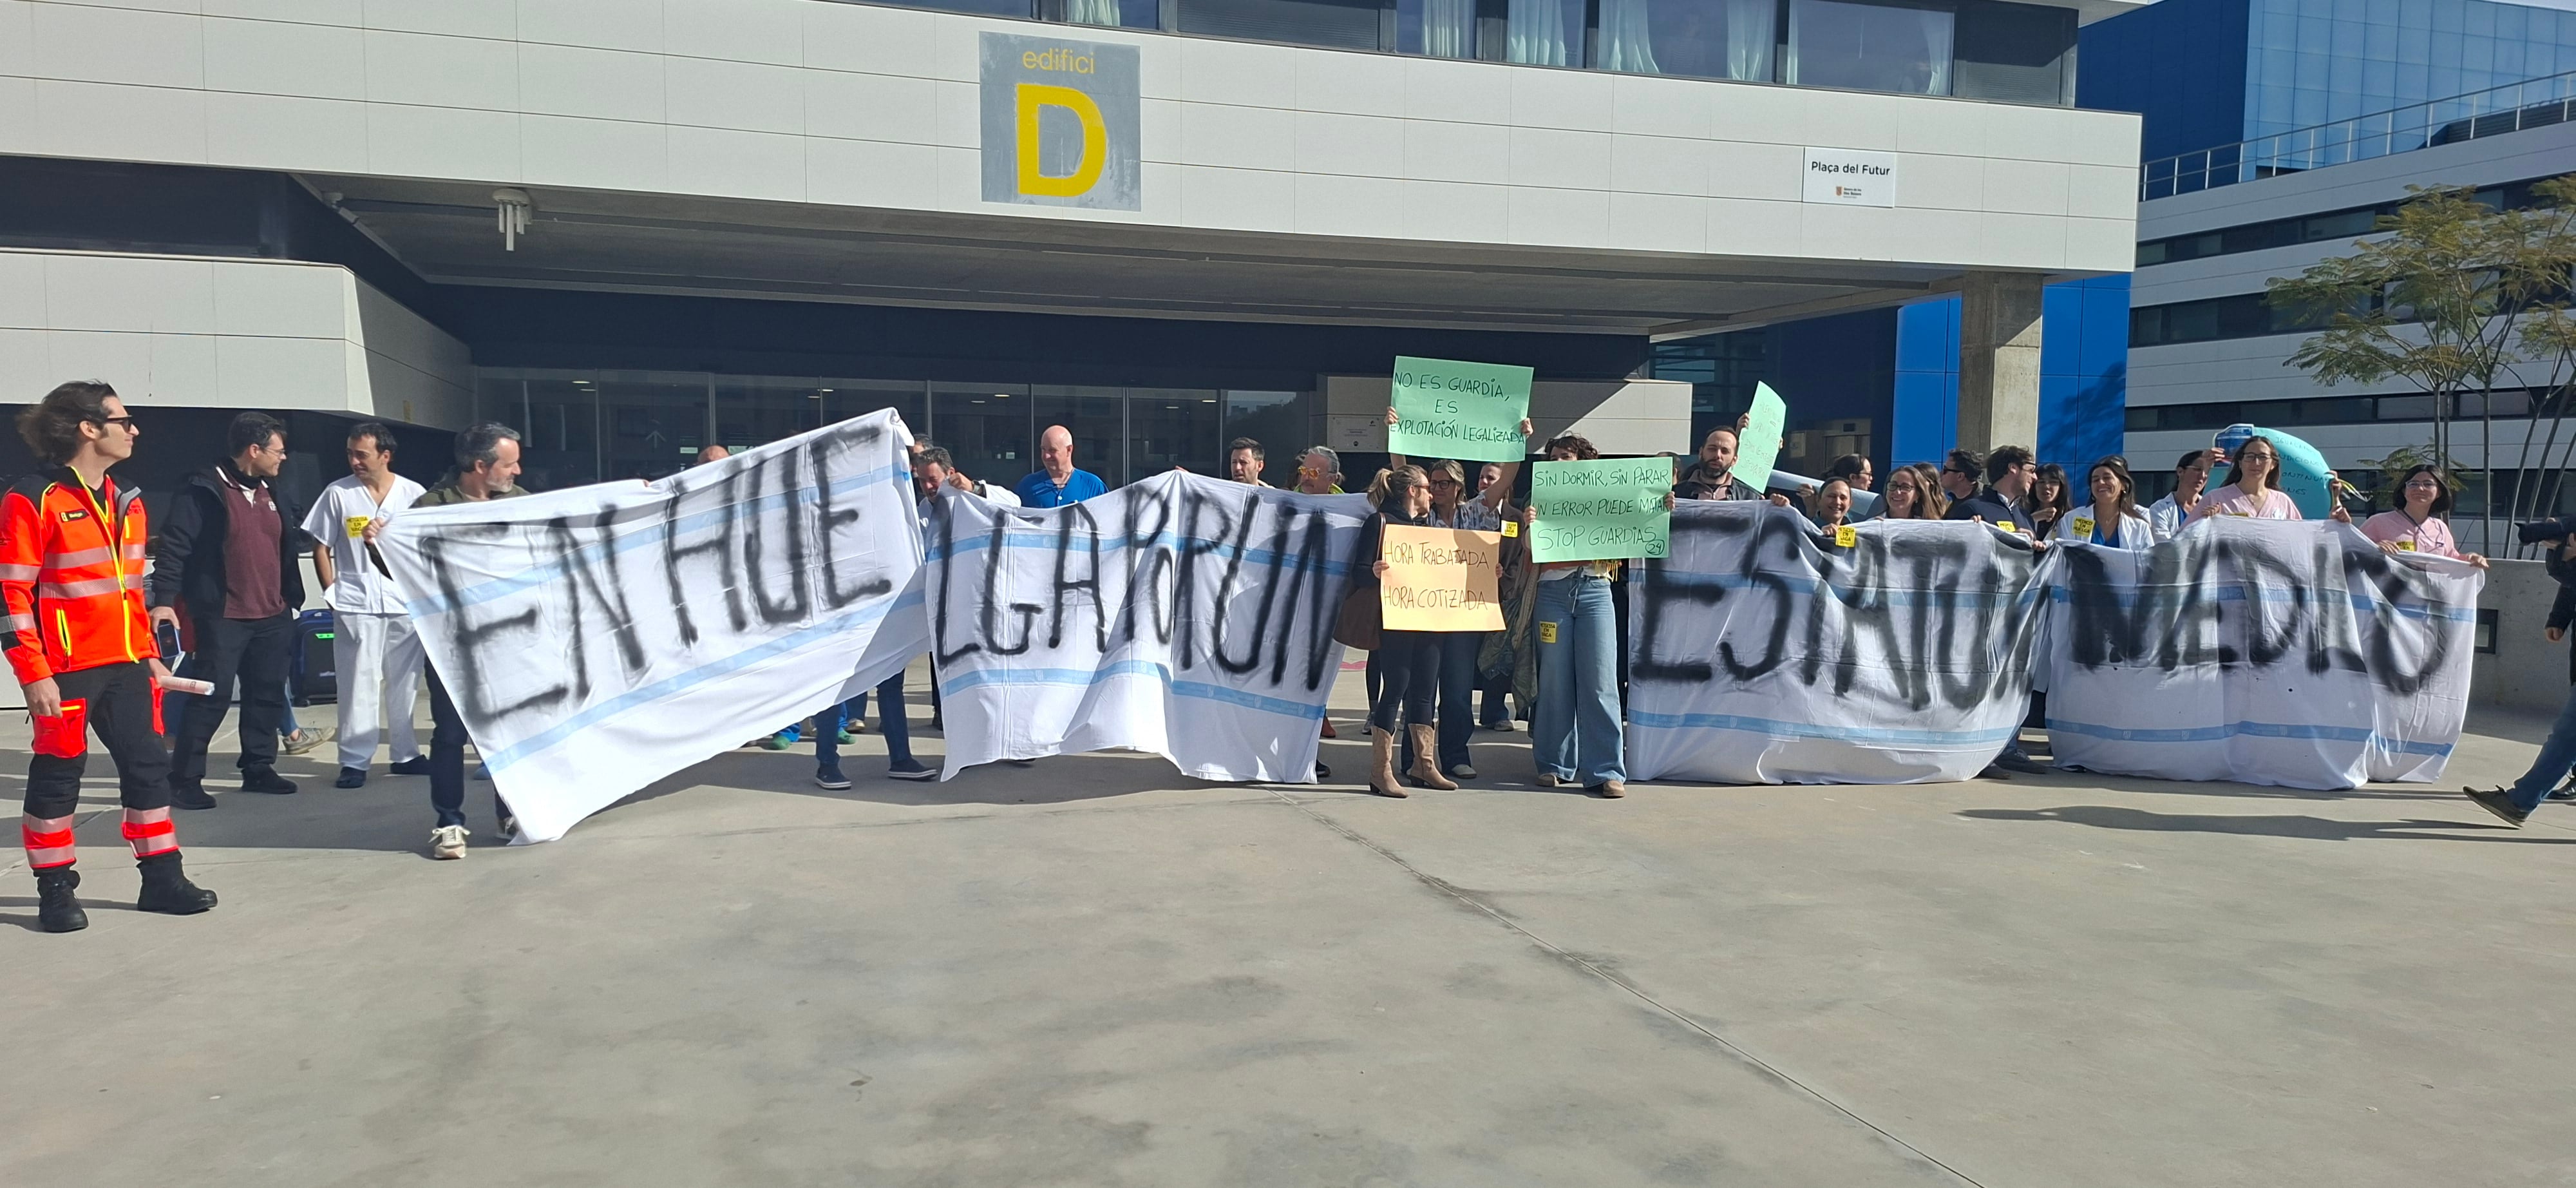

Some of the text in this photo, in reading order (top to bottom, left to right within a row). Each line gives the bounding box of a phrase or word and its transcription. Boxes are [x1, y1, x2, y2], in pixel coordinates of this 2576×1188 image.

[1023, 48, 1094, 74] edifici
[1016, 82, 1107, 197] D
[1812, 161, 1890, 175] Plaça del Futur
[1394, 372, 1412, 388] NO
[1420, 374, 1441, 390] ES
[1435, 399, 1458, 414] ES
[1552, 500, 1593, 517] ERROR
[1597, 499, 1634, 517] PUEDE
[1537, 525, 1586, 550] STOP
[1384, 541, 1490, 570] HORA TRABAJADA
[419, 502, 648, 727] EN
[663, 425, 893, 647] HUE
[934, 493, 1106, 671] LGA
[1383, 584, 1414, 609] HORA
